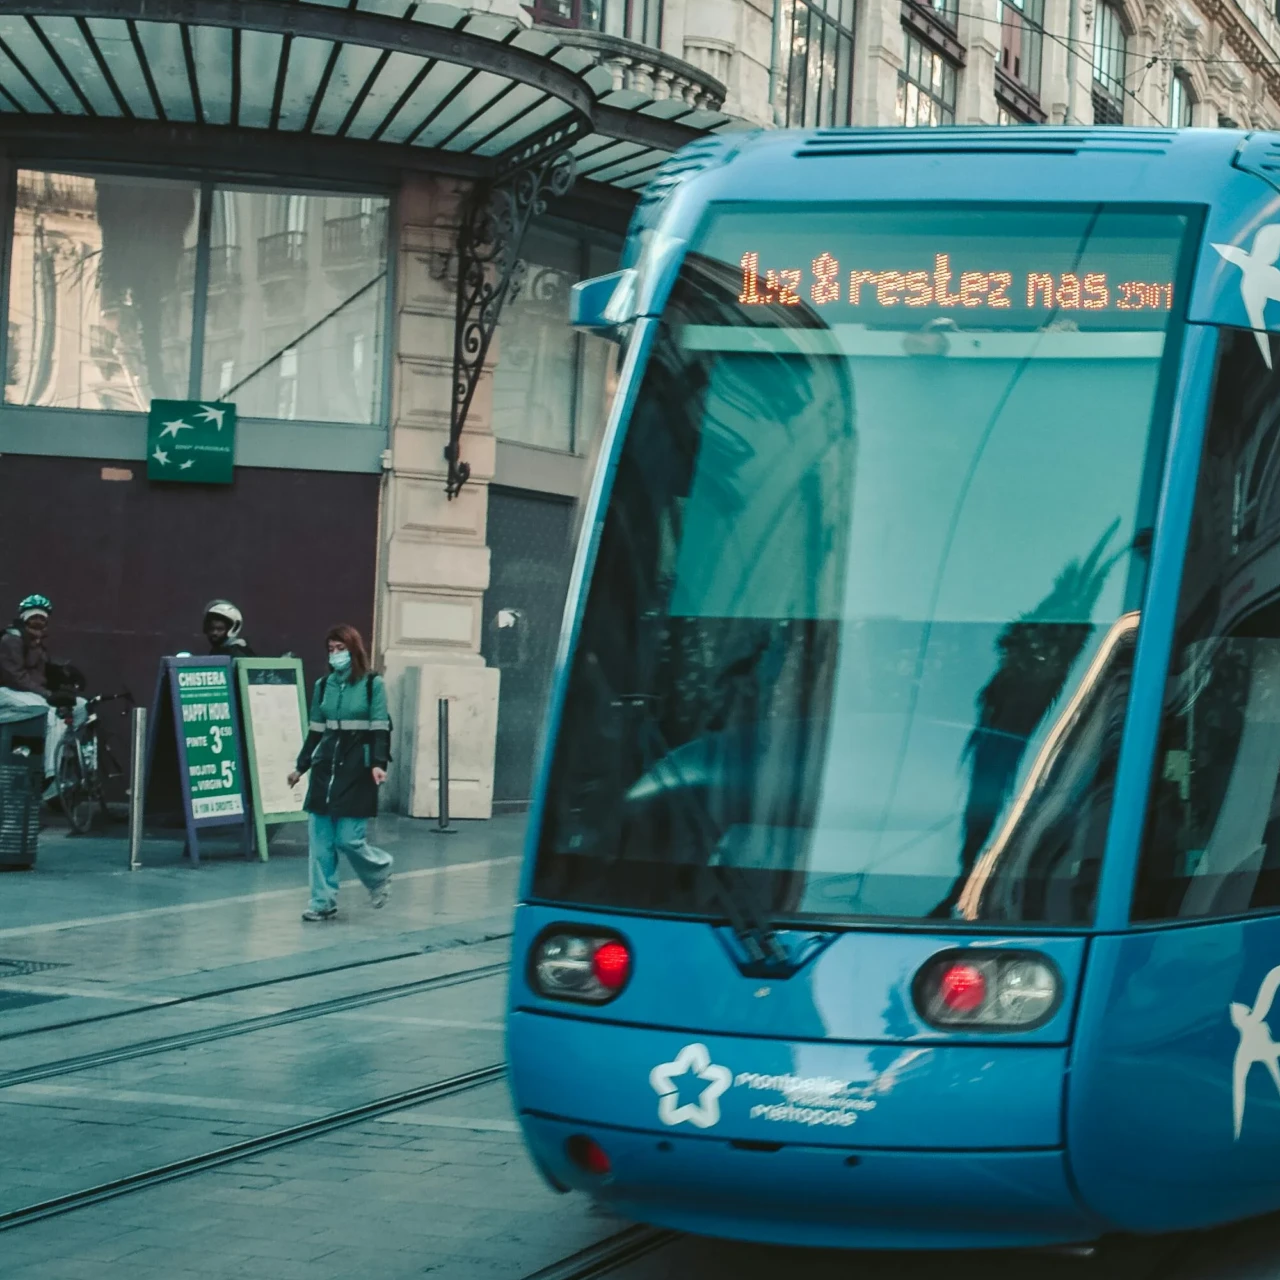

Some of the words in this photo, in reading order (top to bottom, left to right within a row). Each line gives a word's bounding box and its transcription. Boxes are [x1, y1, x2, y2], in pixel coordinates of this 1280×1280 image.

[849, 252, 1012, 308] restez
[178, 671, 227, 687] CHISTERA
[182, 704, 207, 721] HAPPY
[208, 702, 231, 721] HOUR
[186, 736, 208, 748] PINTE
[189, 764, 217, 777] MOJITO
[197, 779, 222, 791] VIRGIN
